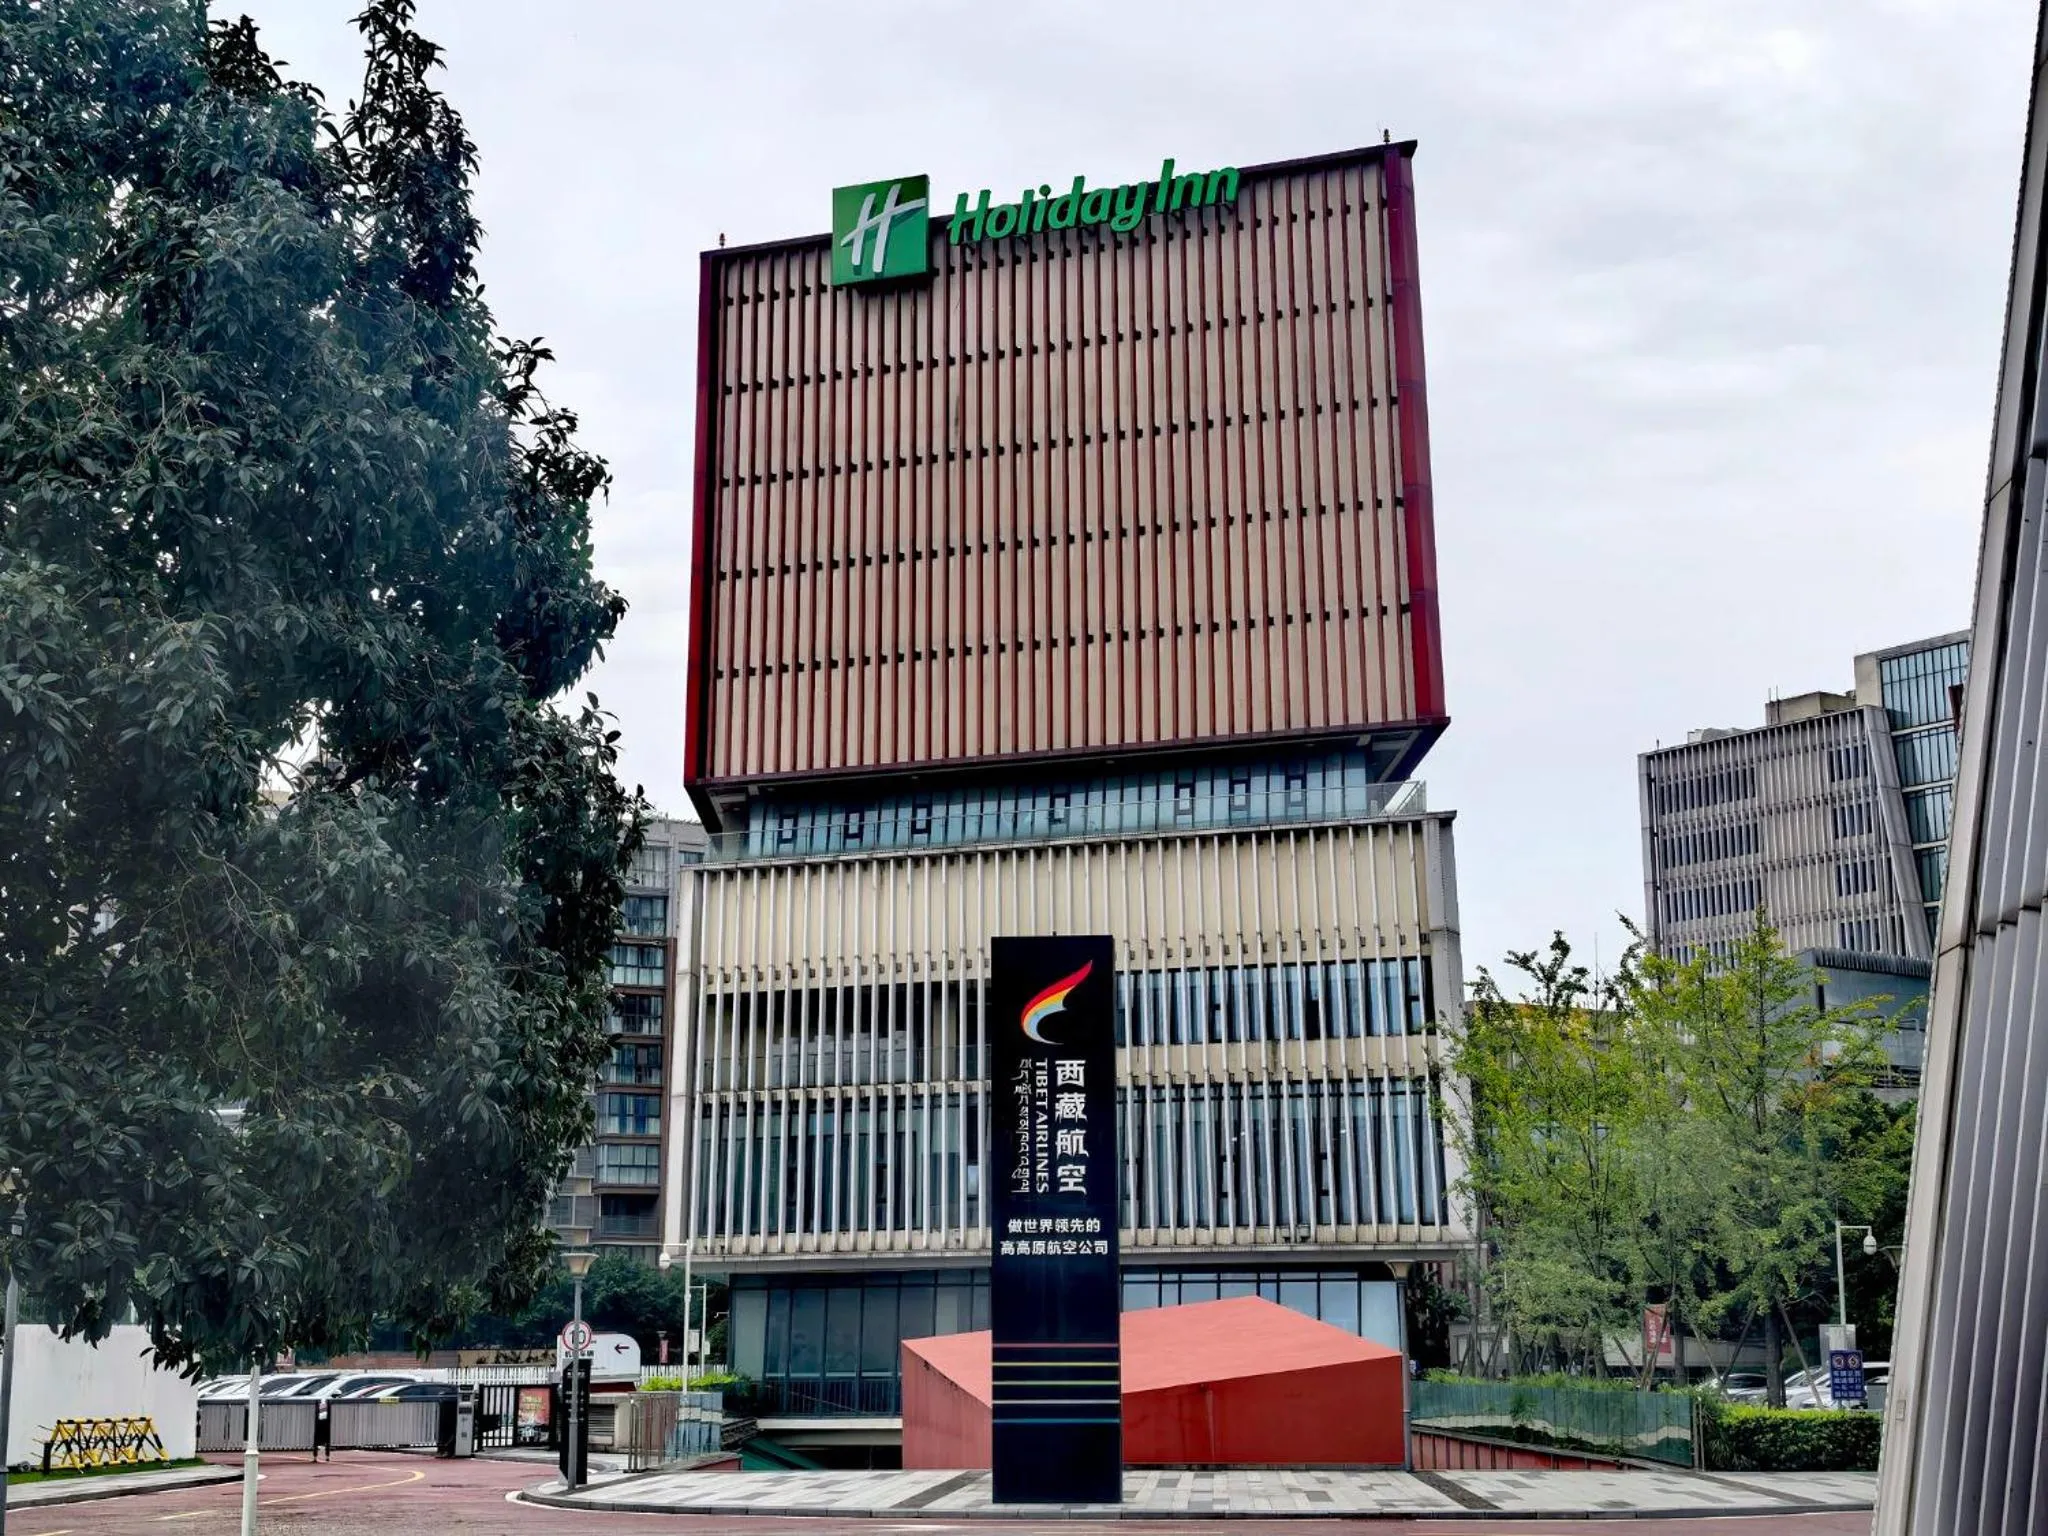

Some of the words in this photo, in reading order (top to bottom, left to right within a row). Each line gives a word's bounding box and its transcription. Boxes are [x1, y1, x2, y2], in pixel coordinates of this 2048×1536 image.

[946, 175, 1149, 246] Holiday
[1155, 158, 1241, 213] Inn
[1035, 1057, 1048, 1110] TIBET
[1035, 1110, 1049, 1194] AIRLINES
[1054, 1059, 1089, 1195] 西藏航空
[1000, 1239, 1109, 1256] 高高原航空公司
[1007, 1217, 1101, 1233] 做世界领先的
